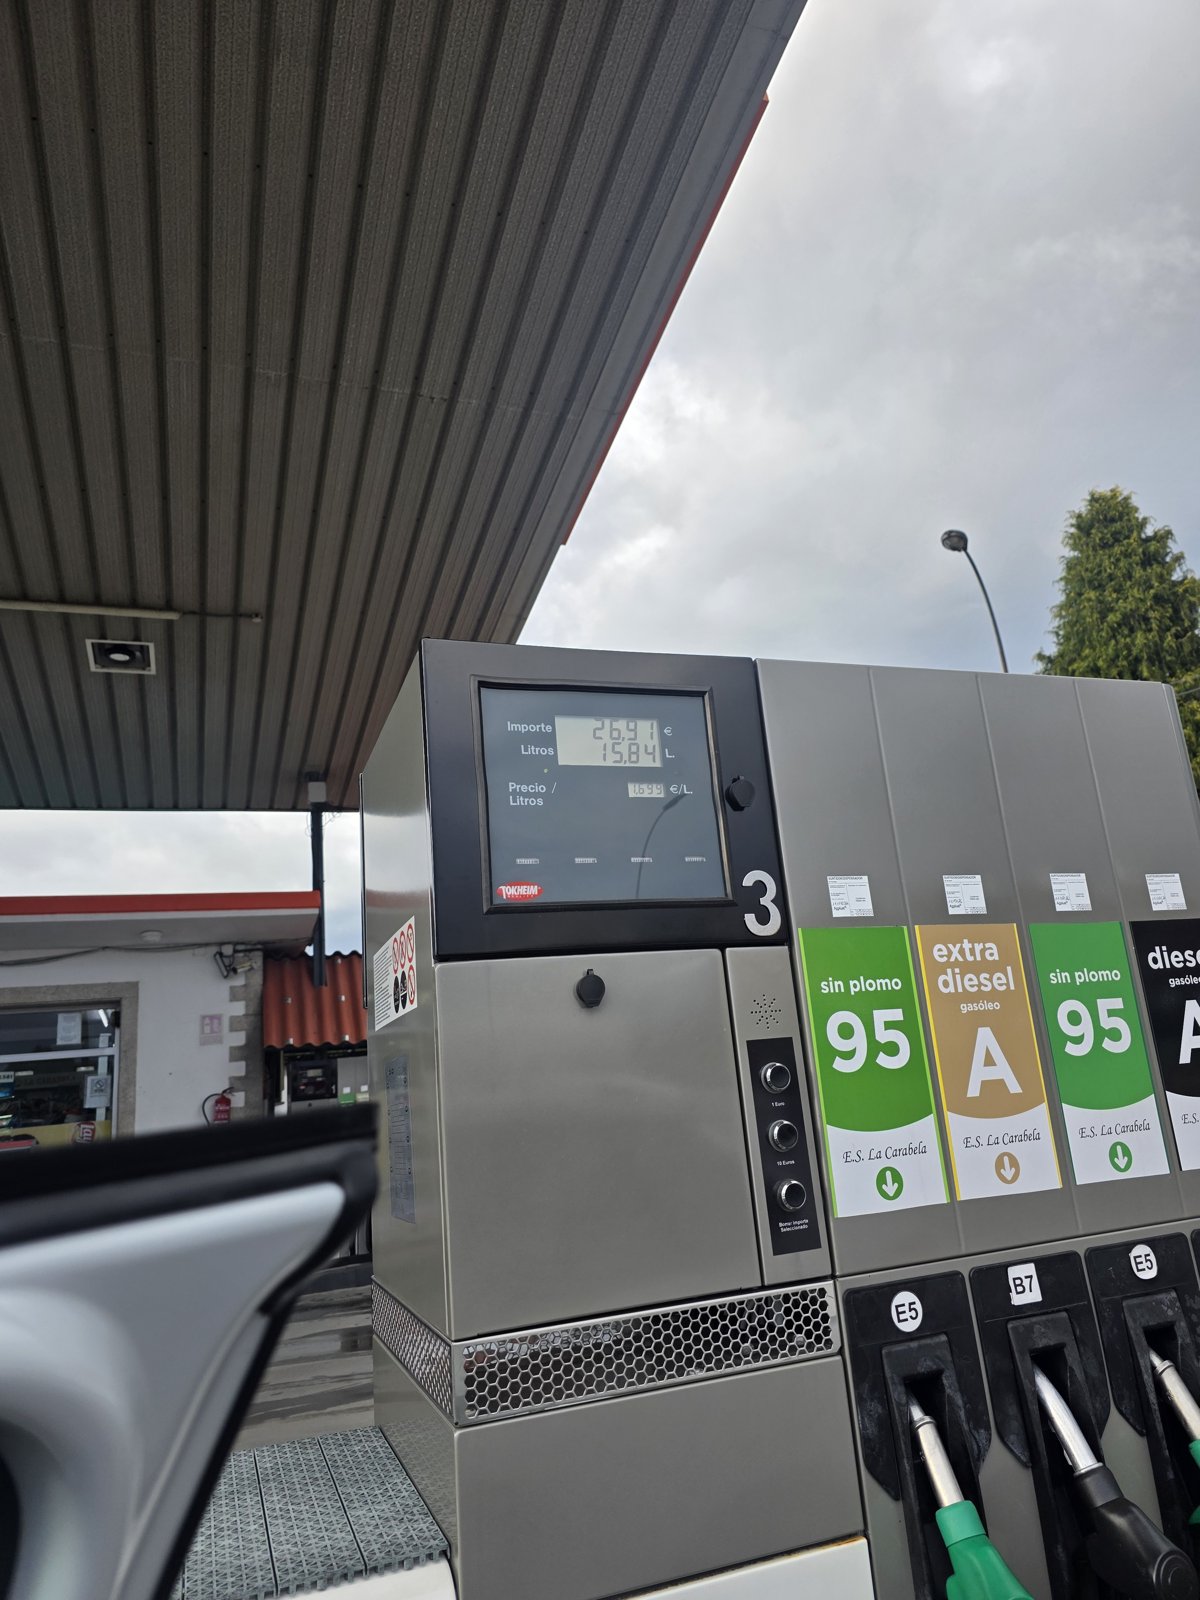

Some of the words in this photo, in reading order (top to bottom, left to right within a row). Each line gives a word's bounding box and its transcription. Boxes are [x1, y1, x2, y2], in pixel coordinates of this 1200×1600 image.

[507, 721, 552, 734] Importe
[521, 745, 554, 755] Litros
[508, 782, 546, 793] Precio
[510, 795, 543, 806] Litros
[499, 885, 538, 899] TOKHEIM
[741, 870, 782, 936] 3
[933, 938, 999, 962] extra
[1147, 945, 1200, 969] dies
[820, 977, 844, 993] sin
[850, 976, 902, 995] plomo
[937, 966, 1015, 993] diesel
[1050, 969, 1070, 984] sin
[1074, 967, 1121, 985] plomo
[960, 1000, 1000, 1014] gasóleo
[1057, 997, 1132, 1056] 95
[826, 1008, 911, 1073] 95
[966, 1026, 1023, 1098] A
[963, 1135, 983, 1149] E.S.
[986, 1134, 999, 1146] La
[1002, 1130, 1041, 1146] Carabela
[1078, 1125, 1098, 1139] E.S.
[1101, 1124, 1113, 1136] La
[1114, 1121, 1151, 1136] Carabela
[842, 1149, 864, 1164] E.S.
[868, 1147, 882, 1161] La
[884, 1143, 927, 1160] Carabela
[1133, 1252, 1154, 1273] E5
[1013, 1274, 1034, 1295] B7
[895, 1300, 919, 1324] E5
